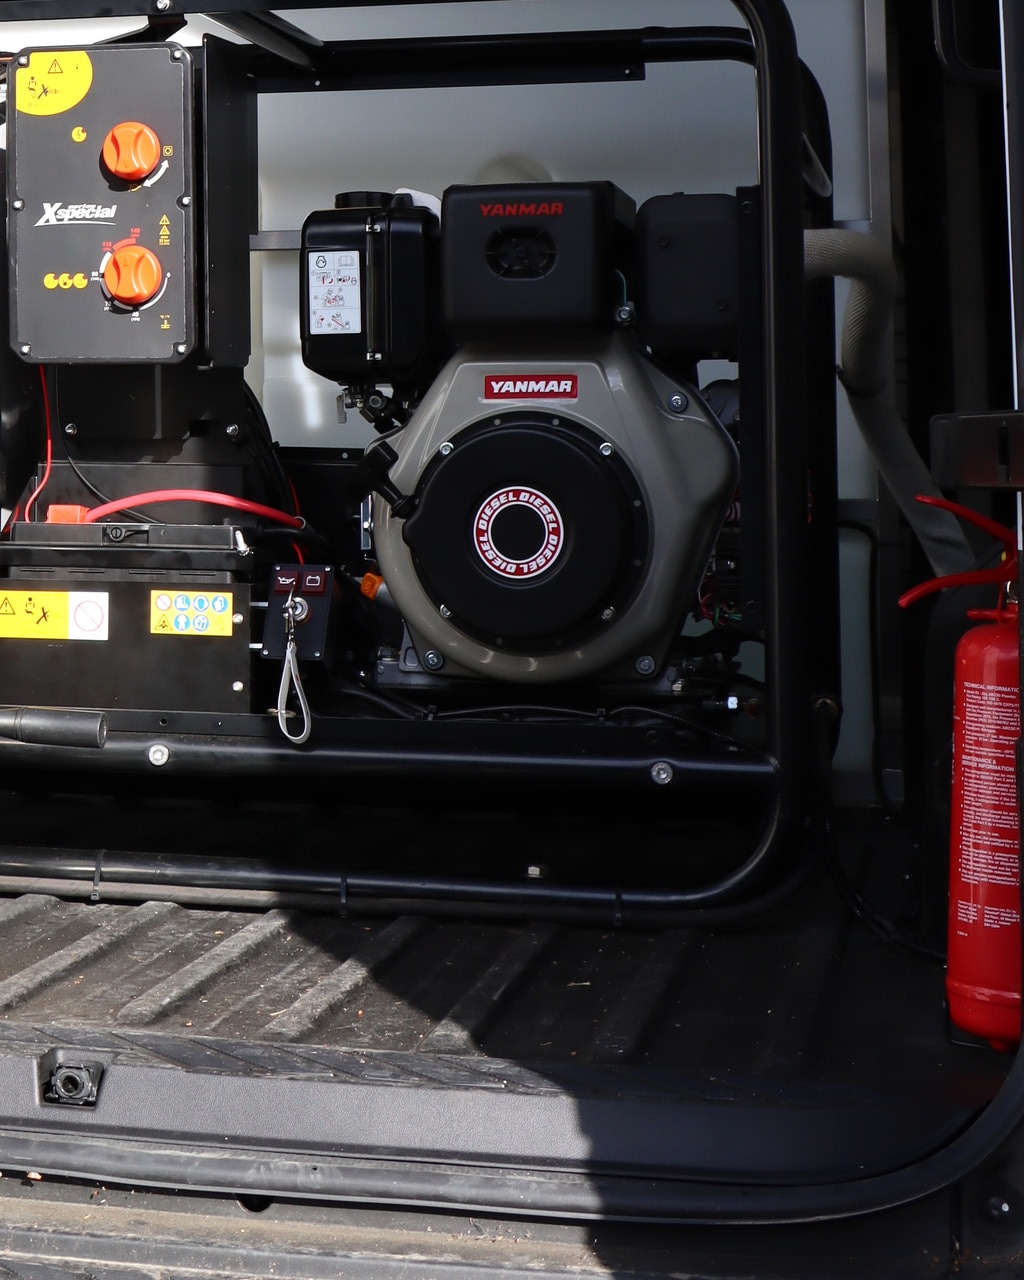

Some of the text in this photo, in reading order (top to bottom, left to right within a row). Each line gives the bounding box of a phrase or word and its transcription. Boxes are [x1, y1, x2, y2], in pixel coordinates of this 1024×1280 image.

[480, 202, 563, 217] YANMAR
[490, 380, 573, 393] YANMAR
[478, 491, 558, 573] DIESEL DIESEL DIESEL DIESEL
[978, 762, 1015, 772] INFORMATION
